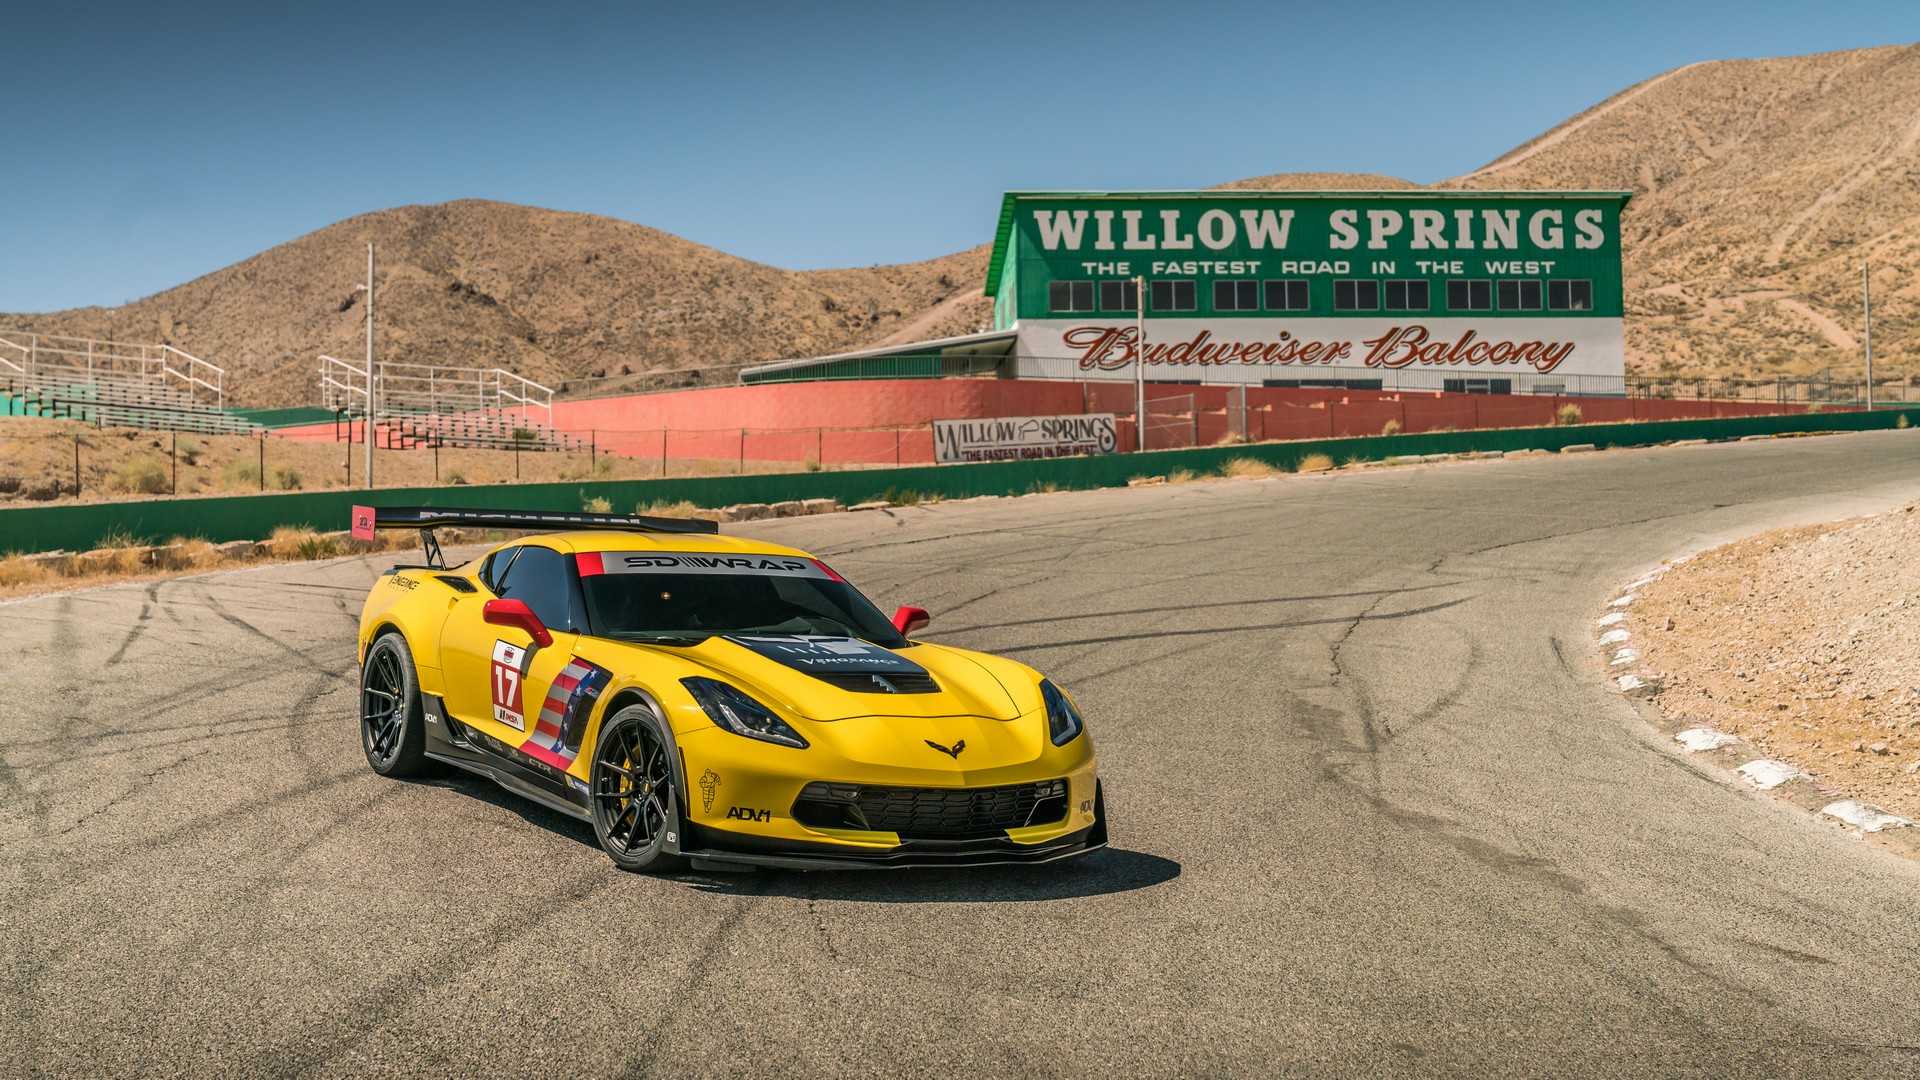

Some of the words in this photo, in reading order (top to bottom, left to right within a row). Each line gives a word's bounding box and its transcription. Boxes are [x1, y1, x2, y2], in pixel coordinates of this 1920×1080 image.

[1033, 209, 1295, 251] WILLOW
[1329, 209, 1605, 250] SPRINGS
[1082, 261, 1130, 275] THE
[1152, 261, 1261, 275] FASTEST
[1282, 261, 1350, 275] ROAD
[1371, 261, 1396, 275] IN
[1416, 261, 1464, 275] THE
[1485, 261, 1556, 275] WEST
[1062, 325, 1352, 370] Budweiser
[1362, 325, 1576, 374] Balcony
[937, 422, 1016, 460] WILLOW
[1041, 417, 1116, 453] SPRINGS
[984, 448, 1018, 460] FASTEST
[1021, 447, 1043, 459] ROAD
[1044, 447, 1053, 457] IN
[1056, 446, 1071, 456] THE
[495, 665, 518, 707] 17
